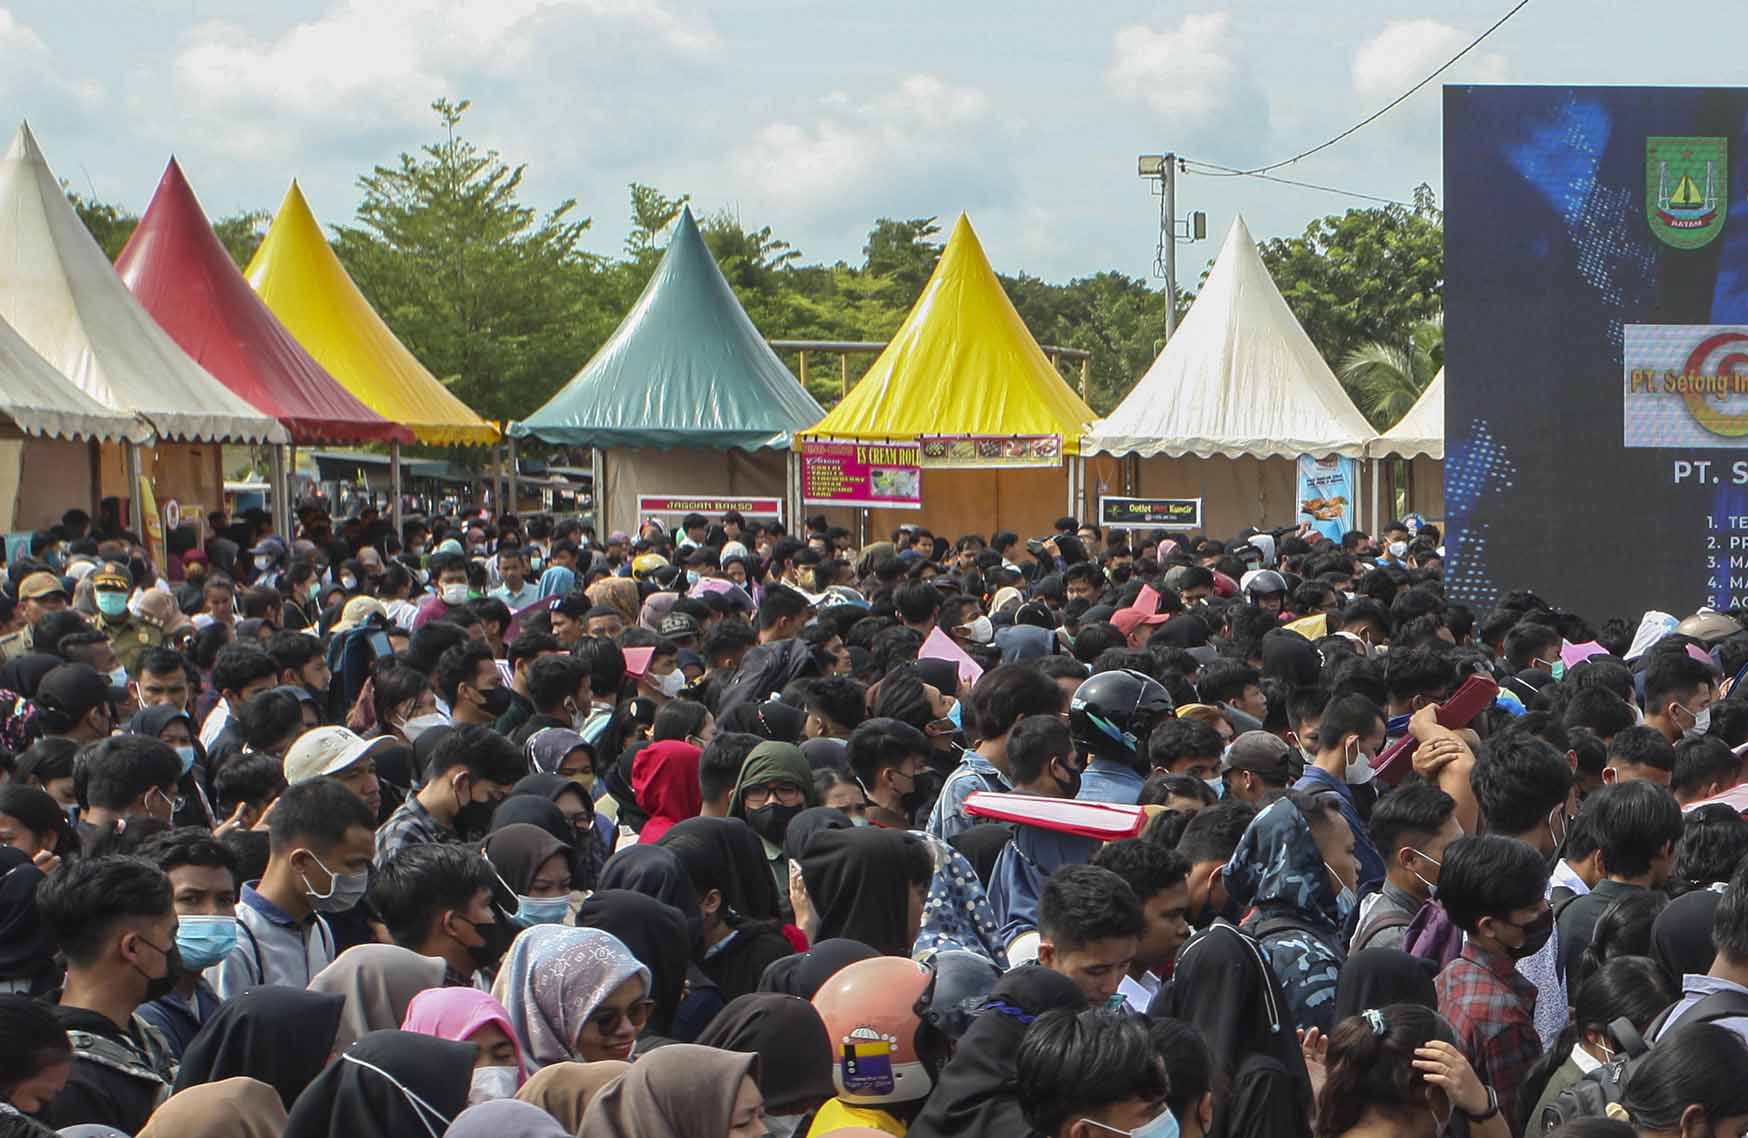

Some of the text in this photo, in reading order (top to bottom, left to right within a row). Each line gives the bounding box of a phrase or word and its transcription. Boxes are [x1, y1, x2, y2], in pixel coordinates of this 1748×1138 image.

[1664, 368, 1730, 400] Sefong
[869, 447, 897, 465] CREAM
[1673, 461, 1720, 485] PT.
[1129, 503, 1152, 513] Outlet
[1707, 516, 1719, 530] 1.
[1707, 537, 1721, 550] 2.
[1707, 556, 1721, 570] 3.
[1707, 576, 1722, 590] 4.
[1707, 596, 1721, 610] 5.
